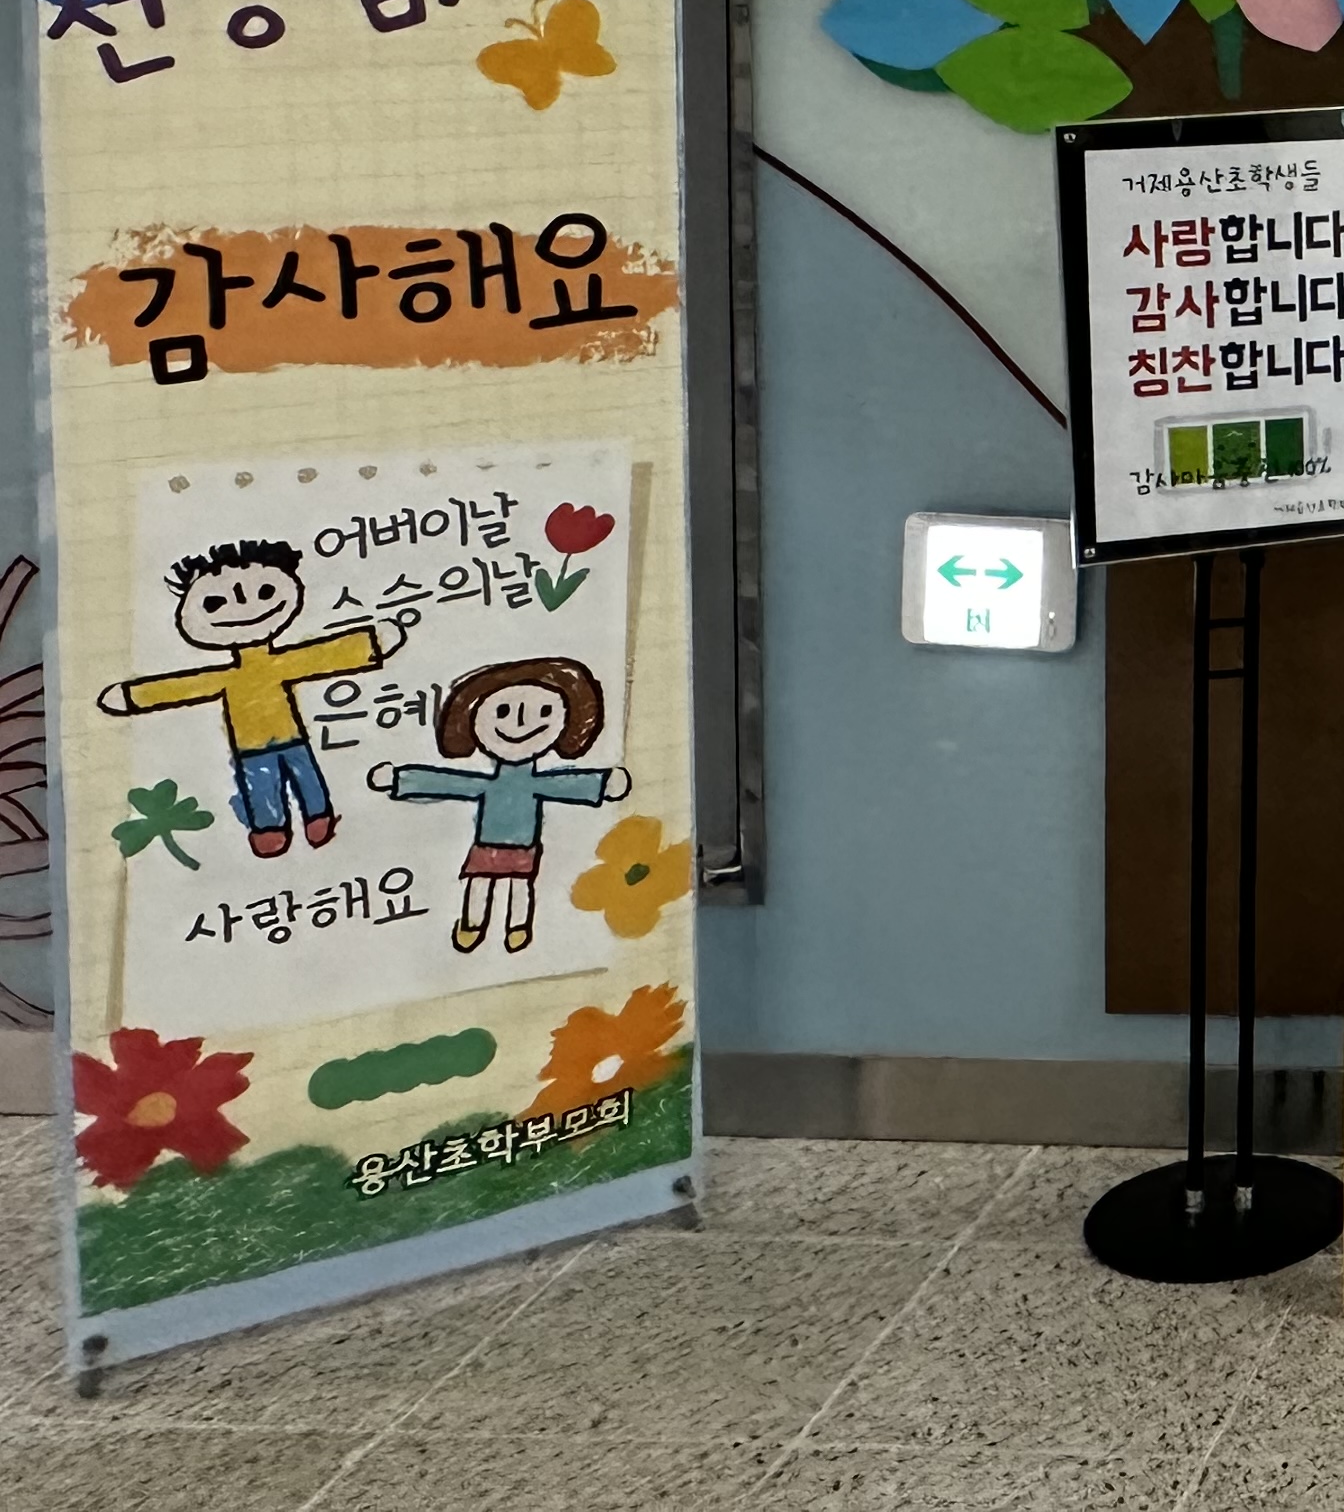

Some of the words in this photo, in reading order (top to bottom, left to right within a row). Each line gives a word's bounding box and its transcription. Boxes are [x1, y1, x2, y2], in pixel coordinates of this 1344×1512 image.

[118, 212, 640, 385] 감사해요
[313, 491, 519, 559] 어버이날
[323, 552, 541, 630] 스승의날
[313, 678, 442, 751] 은혜
[184, 866, 429, 944] 사랑해요
